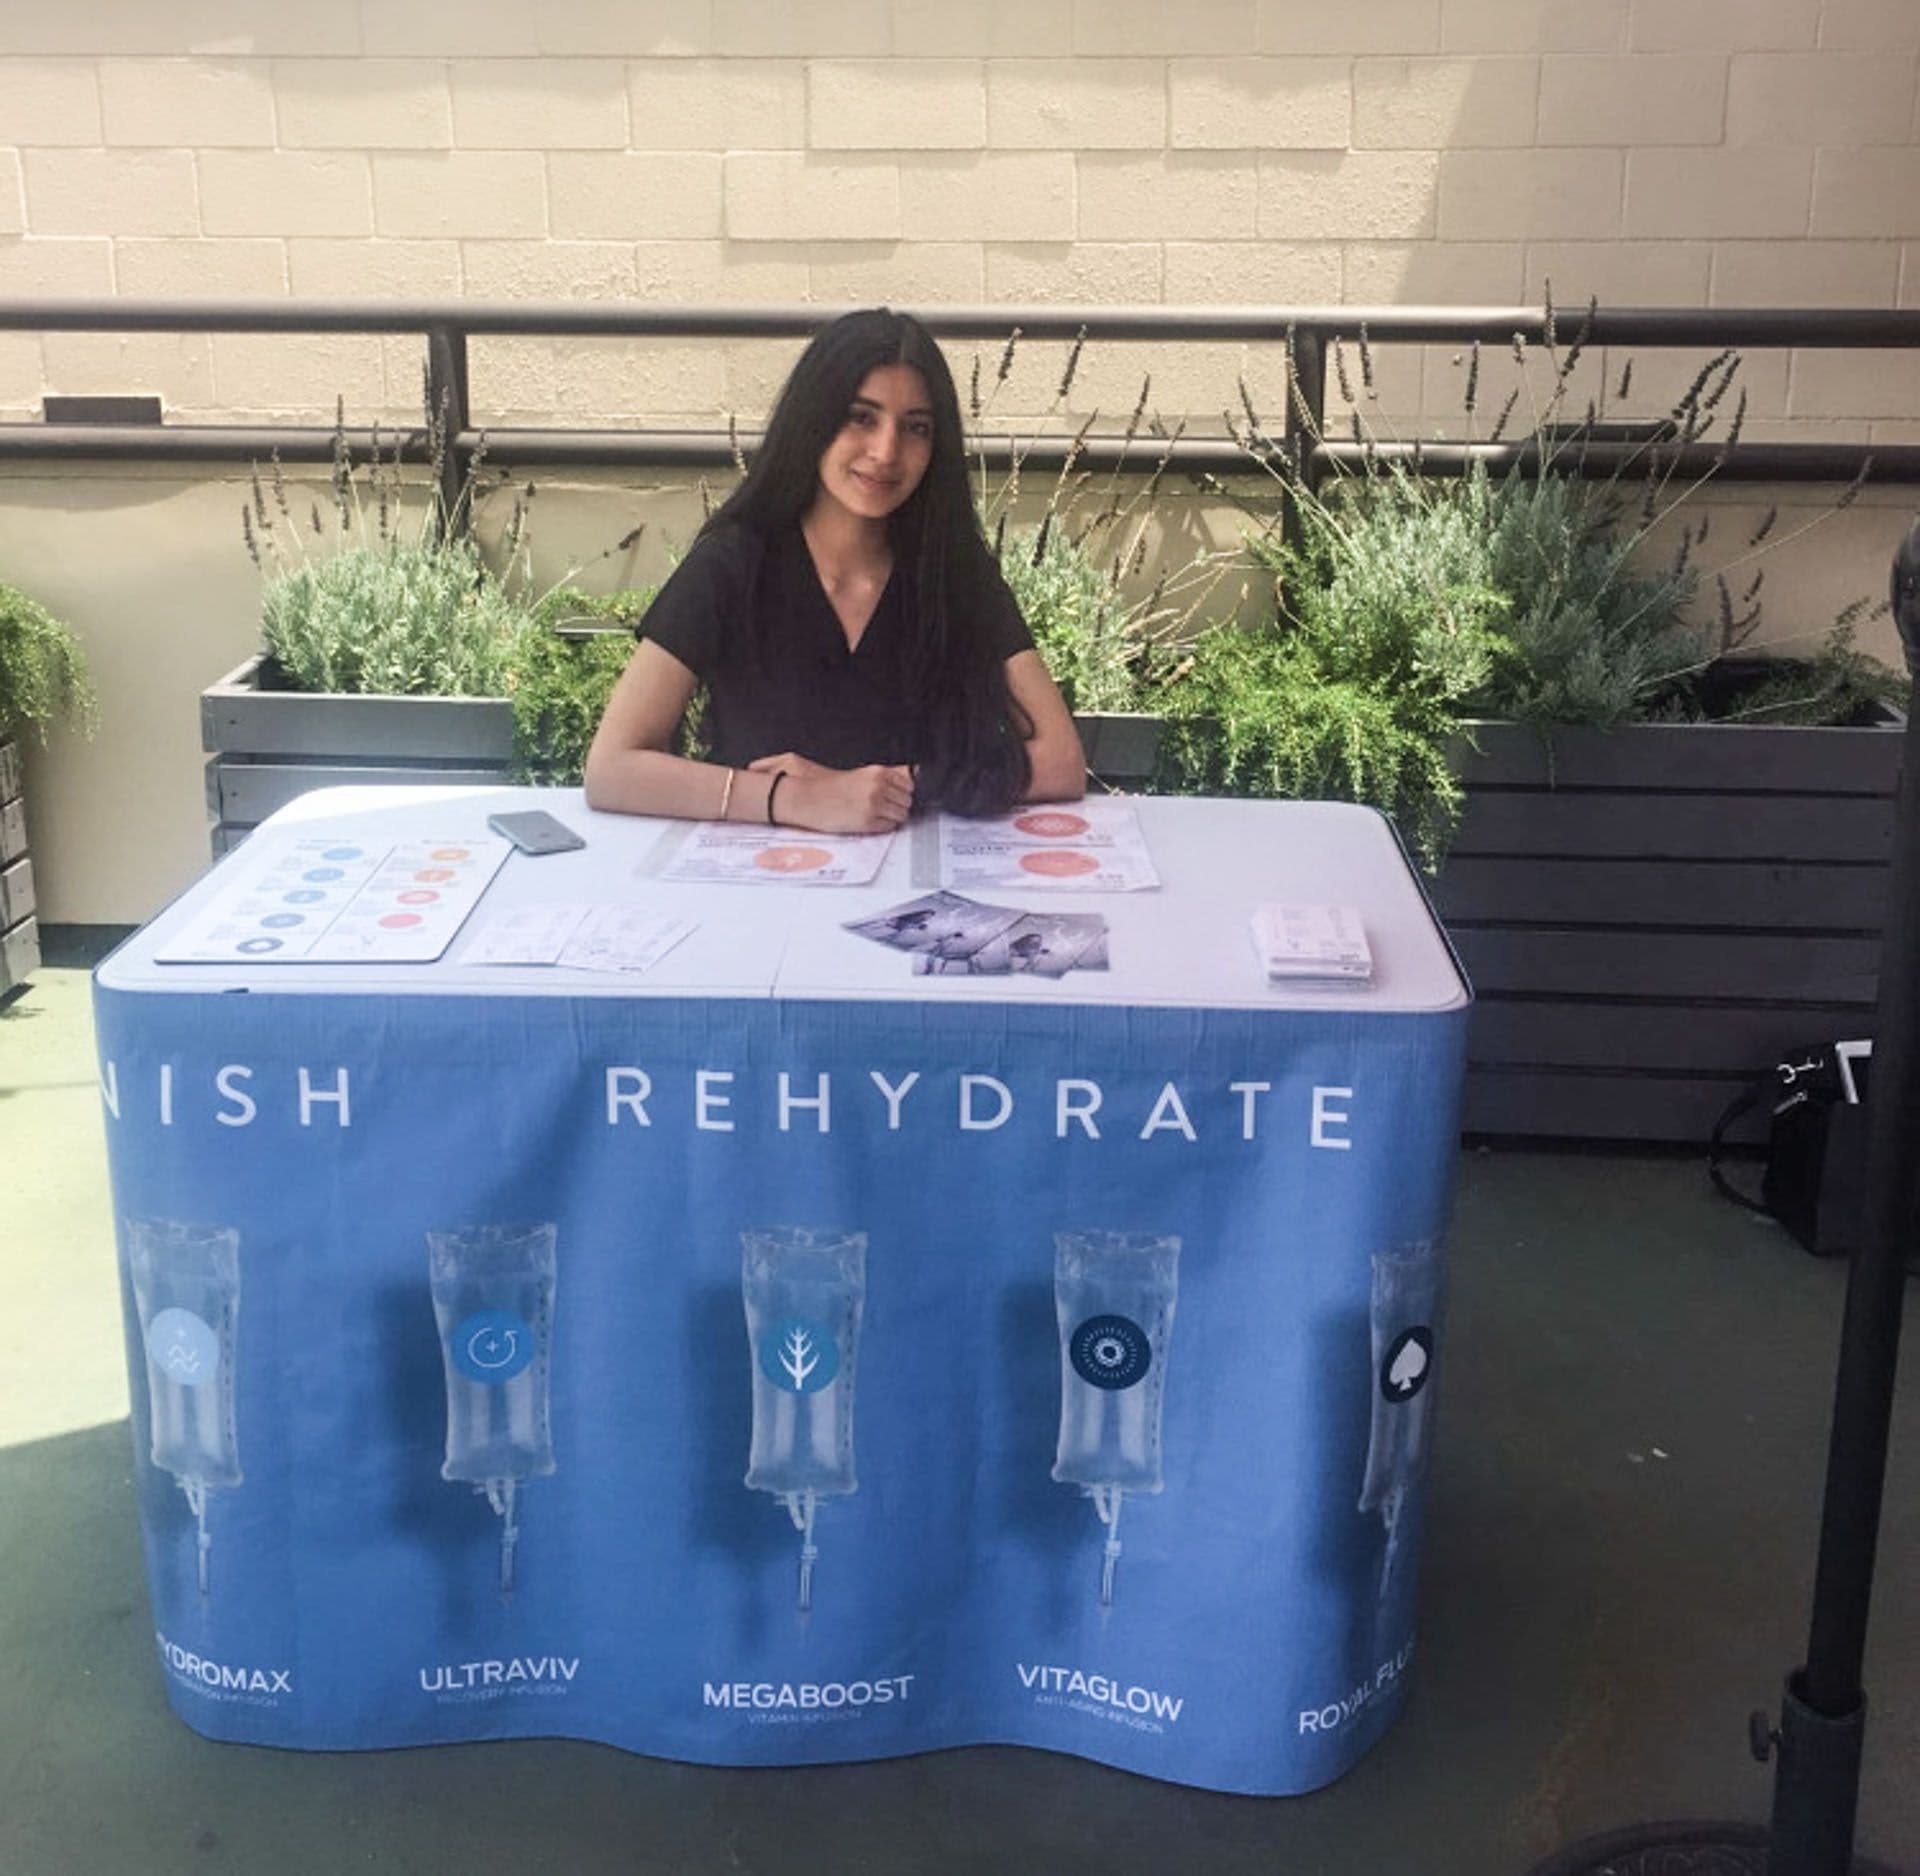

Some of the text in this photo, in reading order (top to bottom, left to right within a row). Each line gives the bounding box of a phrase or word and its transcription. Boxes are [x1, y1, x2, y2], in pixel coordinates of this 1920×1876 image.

[605, 1066, 1354, 1149] REHYDRATE
[420, 1657, 580, 1691] ULTRAVIV
[703, 1674, 915, 1708] MEGABOOST
[1016, 1663, 1184, 1722] VITAGLOW
[1299, 1680, 1373, 1735] ROYAL
[1376, 1632, 1416, 1689] FLU
